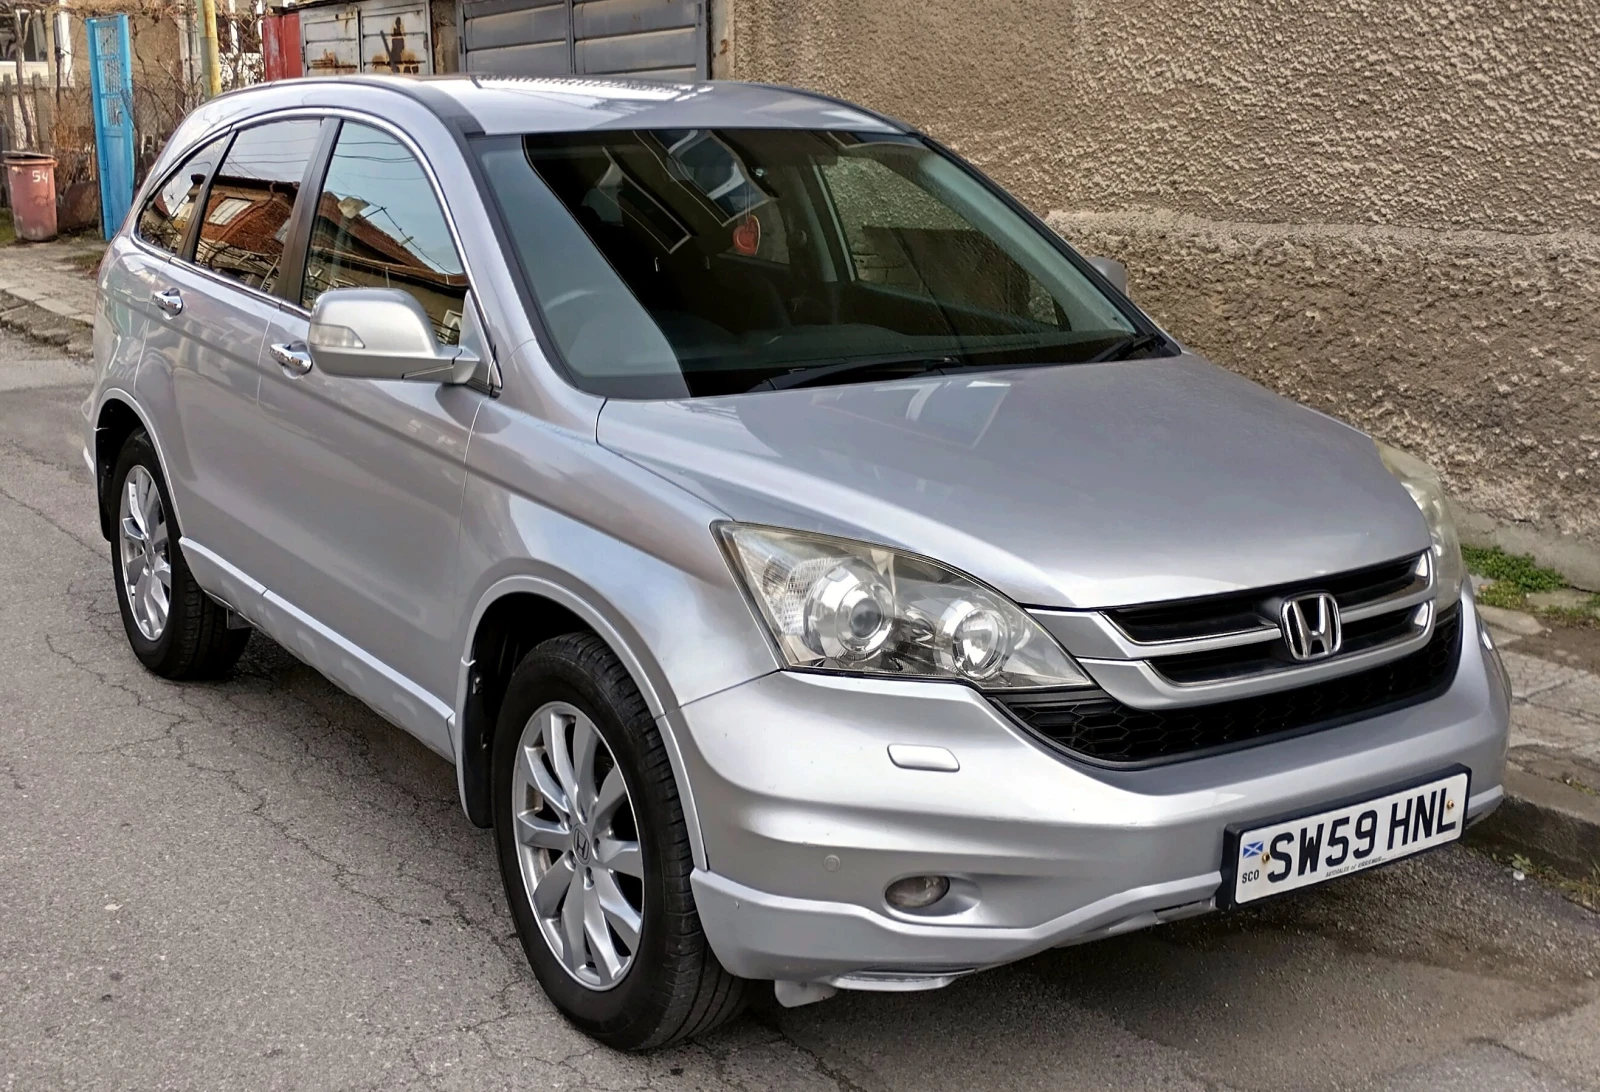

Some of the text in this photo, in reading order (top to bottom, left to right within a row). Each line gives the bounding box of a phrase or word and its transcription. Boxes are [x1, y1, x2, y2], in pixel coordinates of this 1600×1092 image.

[32, 170, 48, 184] 54
[1267, 787, 1456, 883] SW59 HNL
[1242, 869, 1260, 884] SCO
